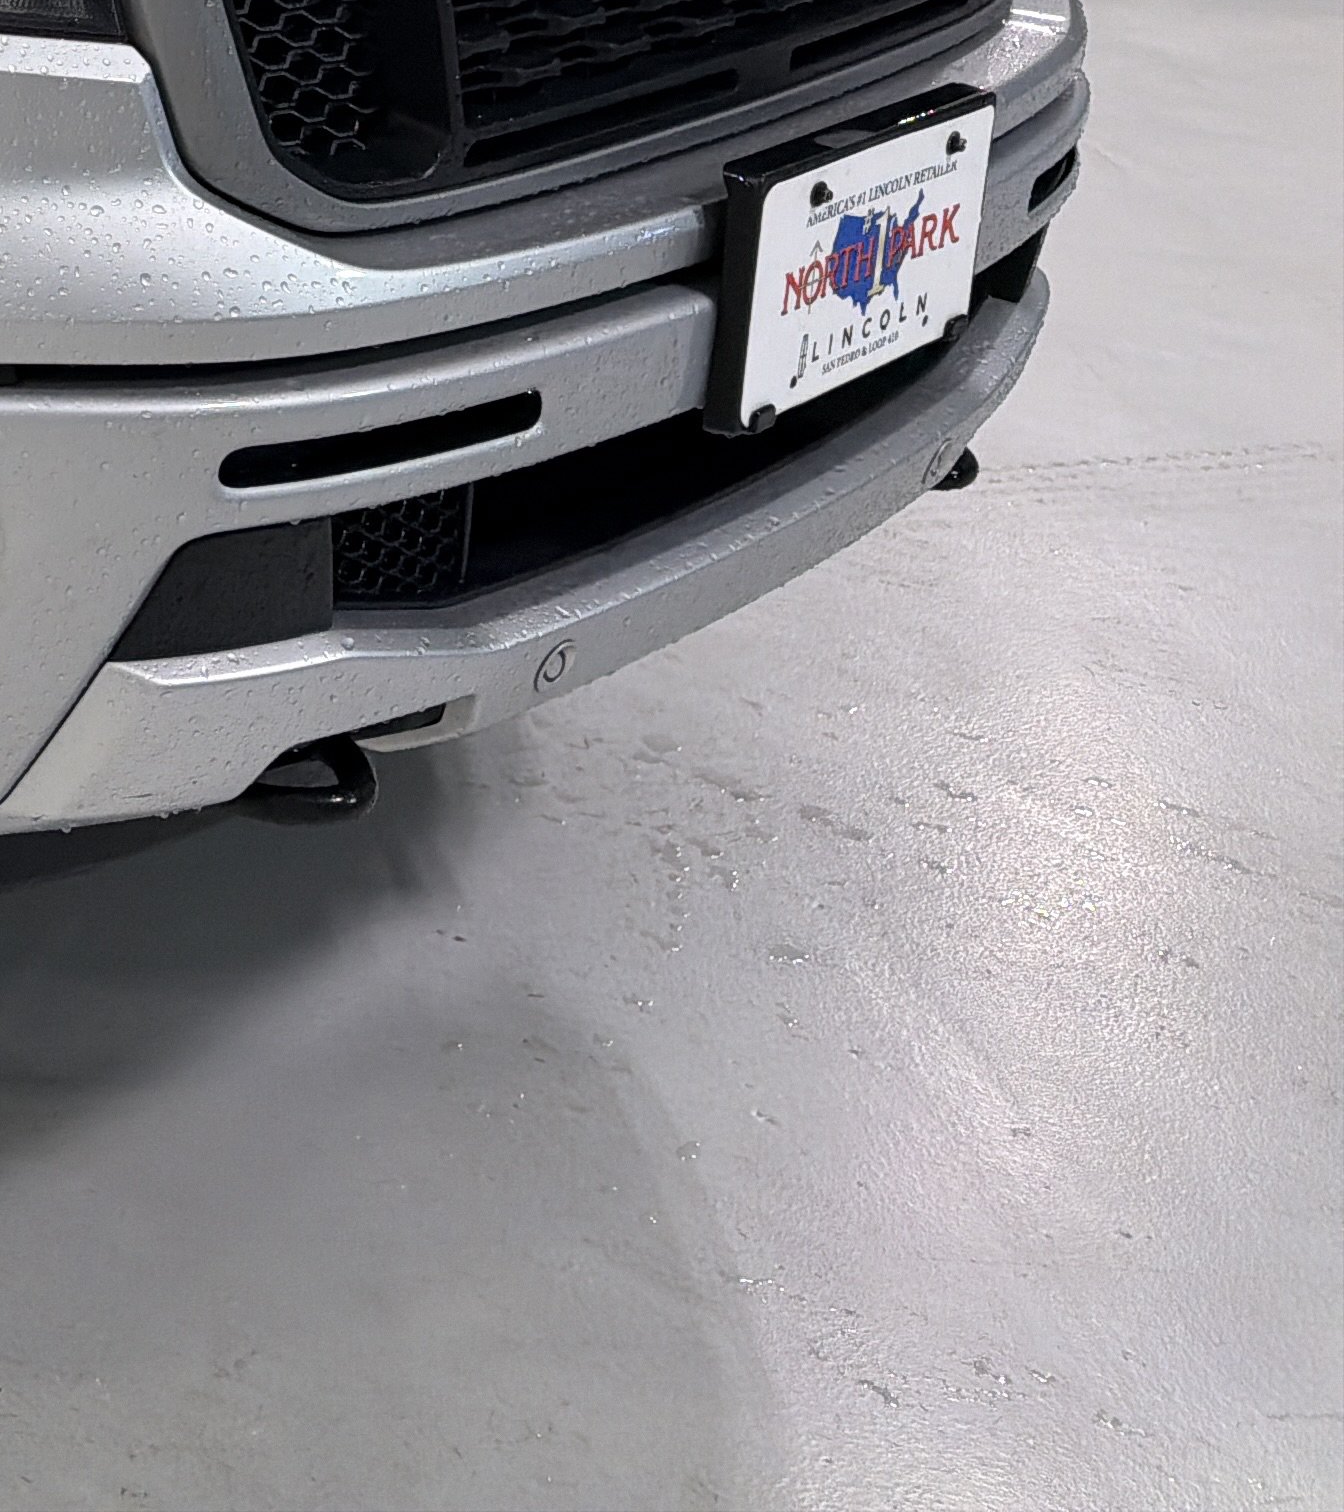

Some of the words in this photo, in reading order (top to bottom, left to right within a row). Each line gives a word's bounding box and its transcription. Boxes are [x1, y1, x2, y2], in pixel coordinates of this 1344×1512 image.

[867, 173, 914, 203] LINCOLN
[780, 234, 876, 317] NORTH
[885, 202, 961, 270] PARK
[811, 292, 929, 363] LINCOLN
[821, 358, 837, 376] SAN
[835, 347, 861, 369] PEDRO
[868, 335, 888, 354] LOOP
